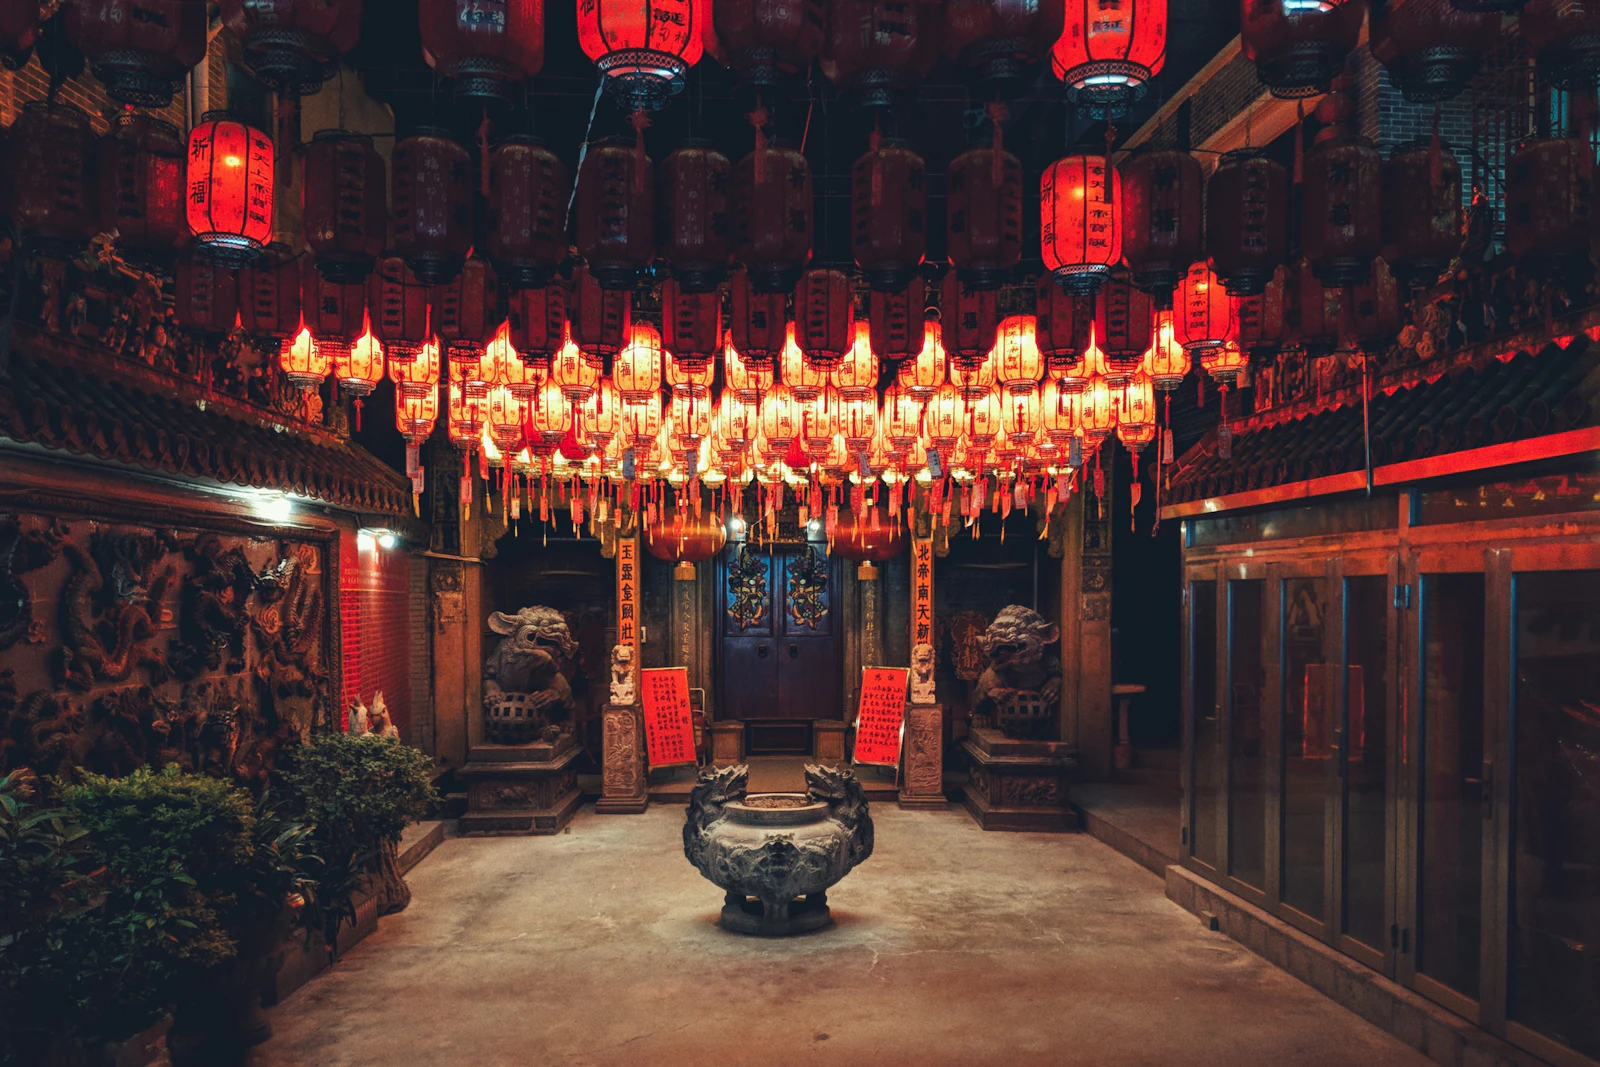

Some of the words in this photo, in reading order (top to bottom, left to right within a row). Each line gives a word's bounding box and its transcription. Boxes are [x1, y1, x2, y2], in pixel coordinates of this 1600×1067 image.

[190, 137, 208, 205] 祈福
[917, 544, 930, 646] 北帝南天新
